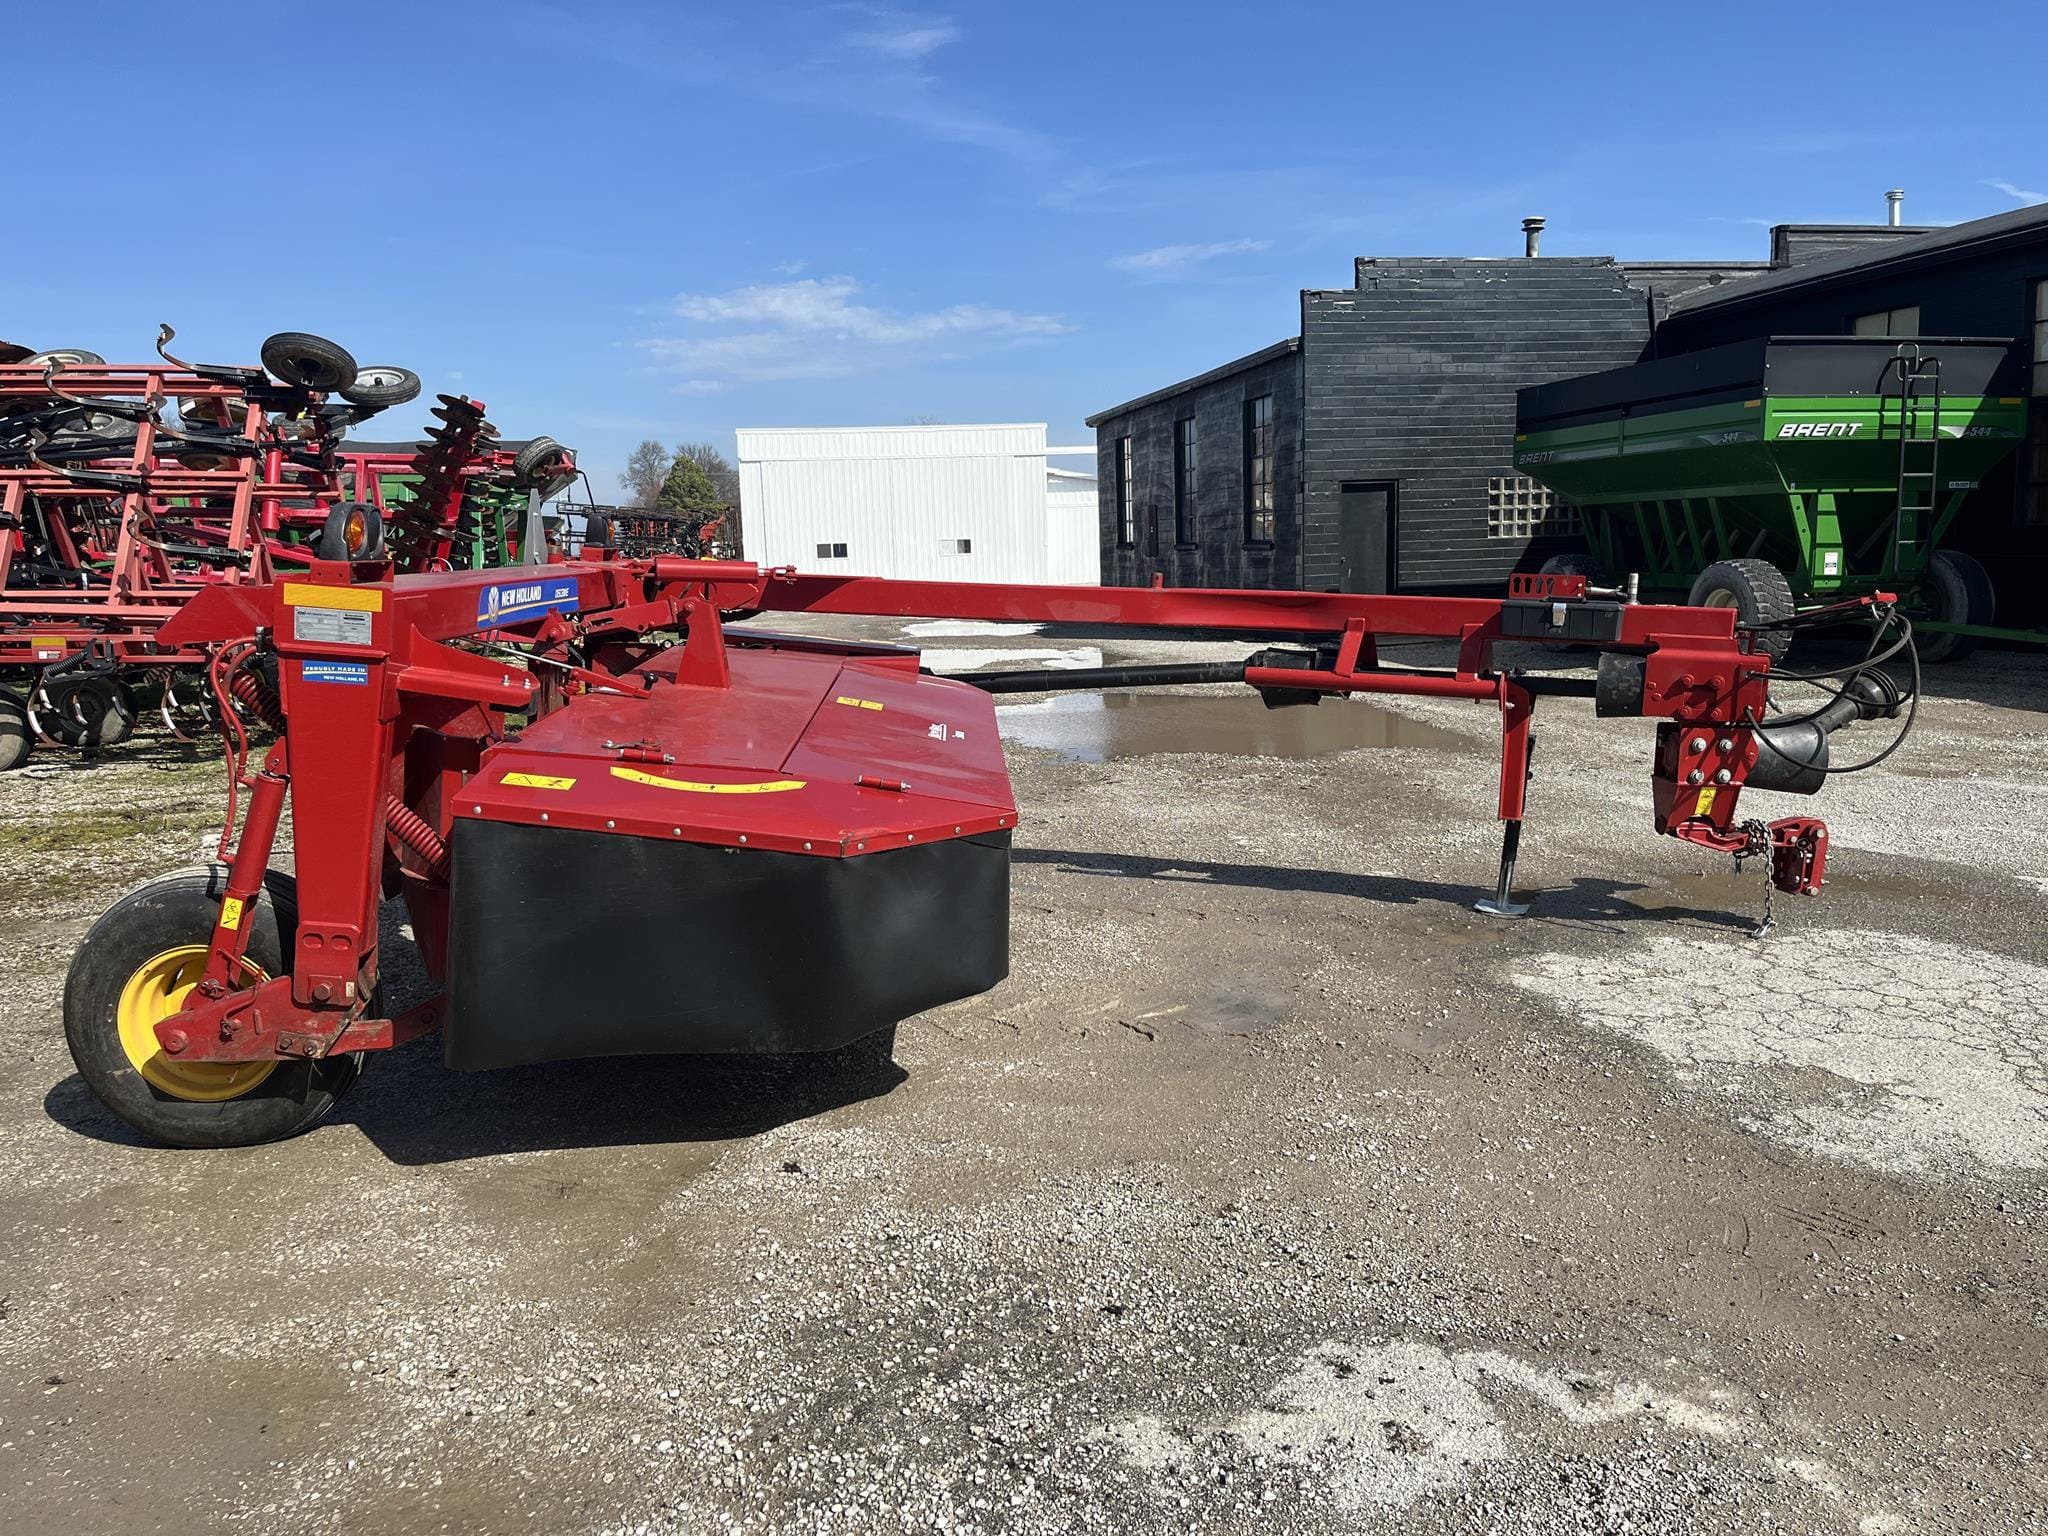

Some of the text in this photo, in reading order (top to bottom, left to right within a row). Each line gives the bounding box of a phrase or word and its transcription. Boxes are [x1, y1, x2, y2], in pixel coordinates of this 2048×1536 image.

[1721, 431, 1739, 443] 544
[1778, 422, 1863, 437] BRENT
[1969, 426, 1991, 437] 544
[1518, 450, 1556, 465] BRENT
[501, 589, 516, 607] NEW
[516, 585, 542, 604] HOLLAND
